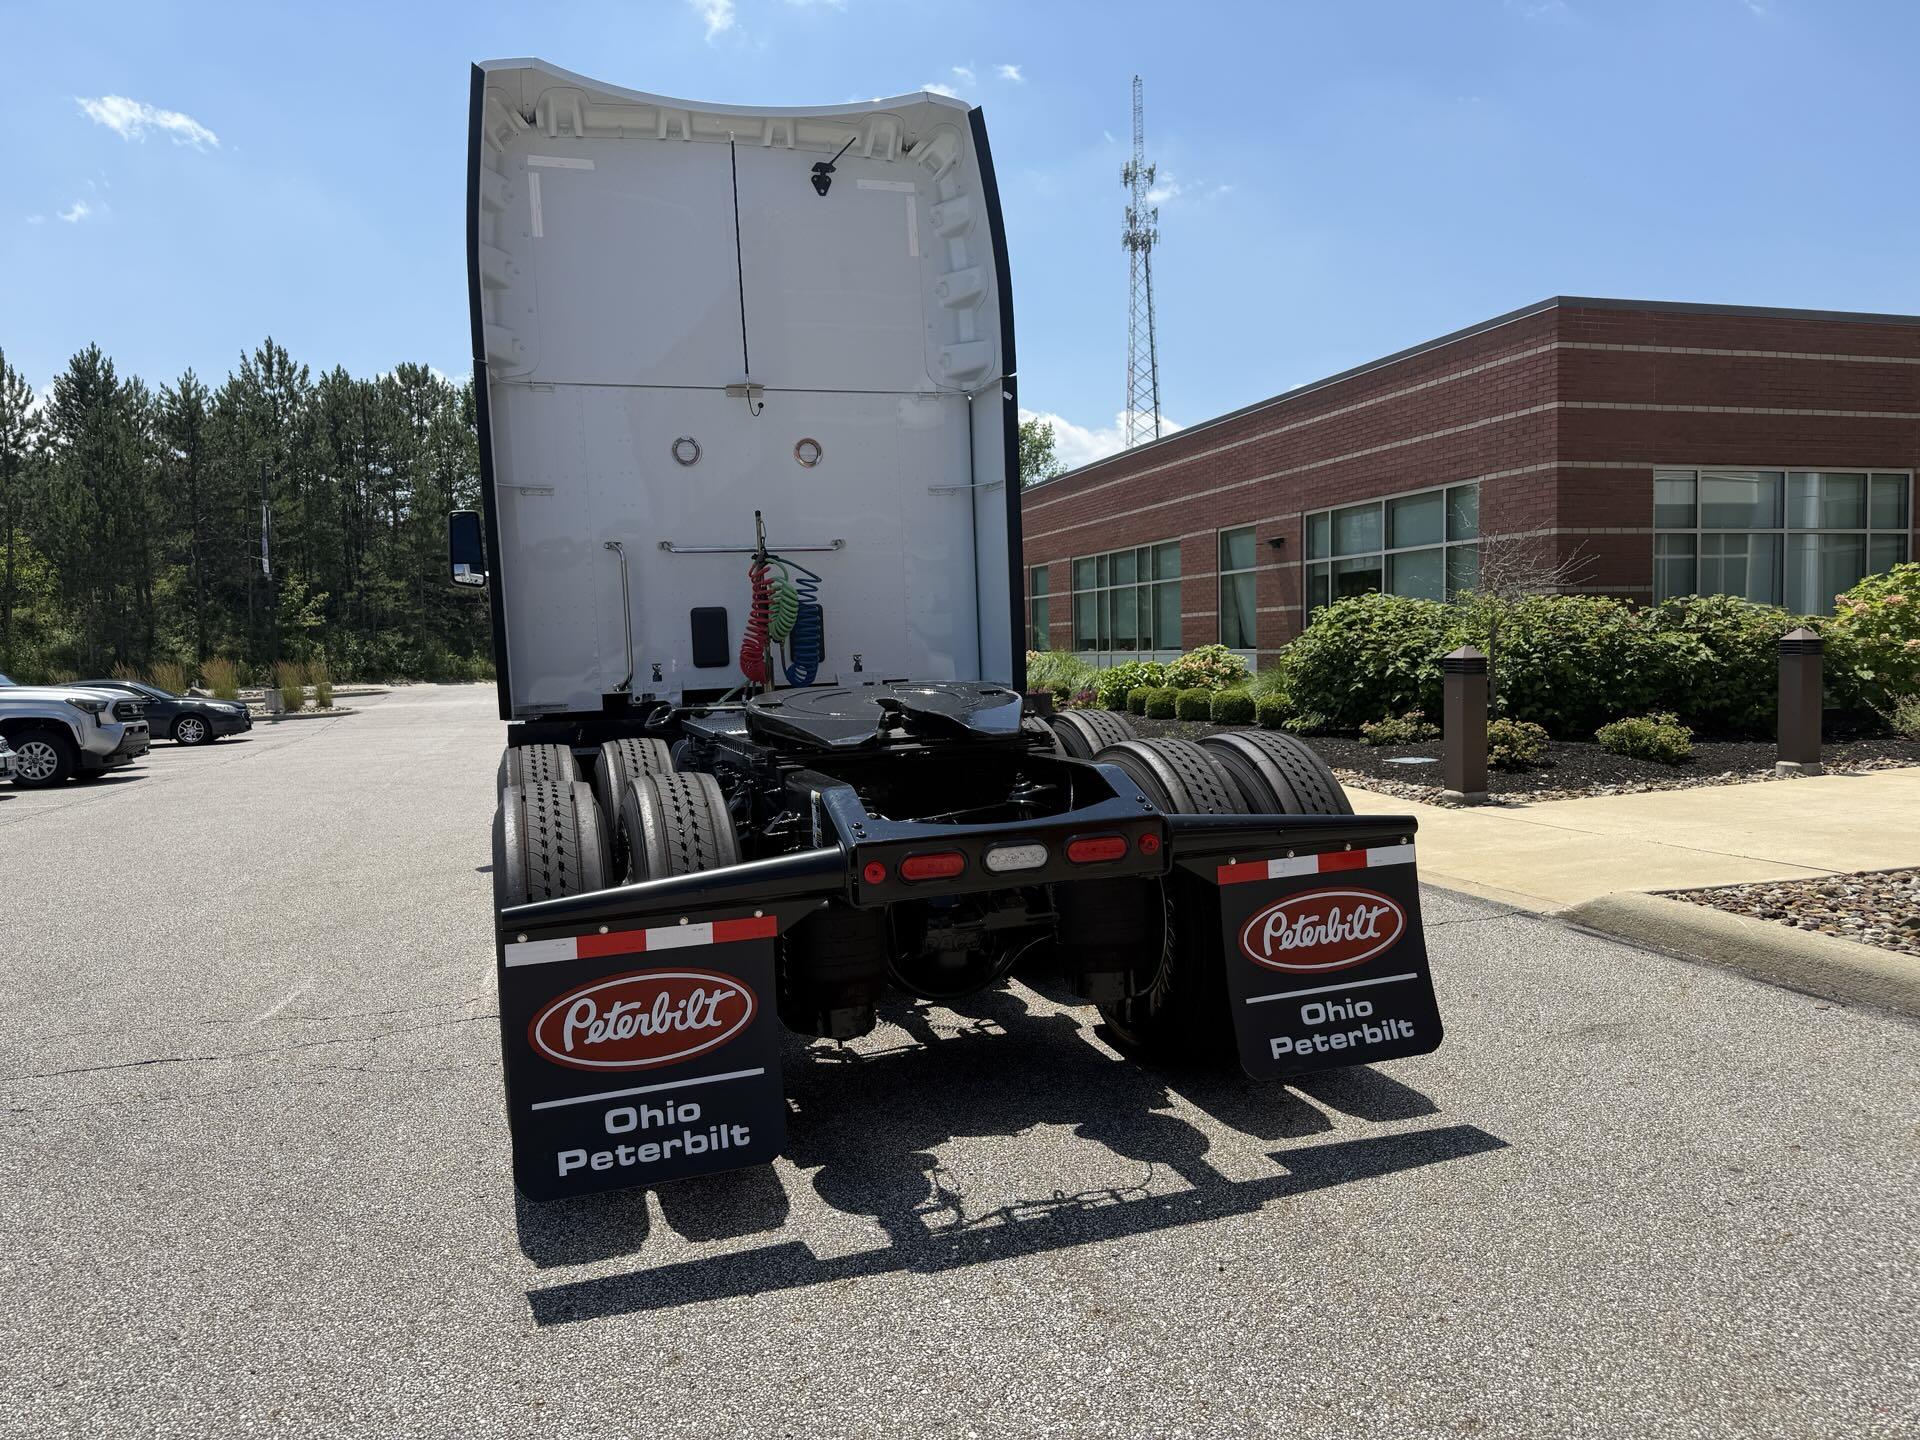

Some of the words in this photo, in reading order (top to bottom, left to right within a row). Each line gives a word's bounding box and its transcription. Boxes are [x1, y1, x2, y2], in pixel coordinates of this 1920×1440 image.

[1263, 904, 1390, 957] Peterbilt
[563, 987, 737, 1052] Peterbilt
[1300, 998, 1374, 1026] Ohio
[1269, 1018, 1415, 1060] Peterbilt
[603, 1100, 701, 1134] Ohio
[557, 1123, 751, 1177] Peterbilt
